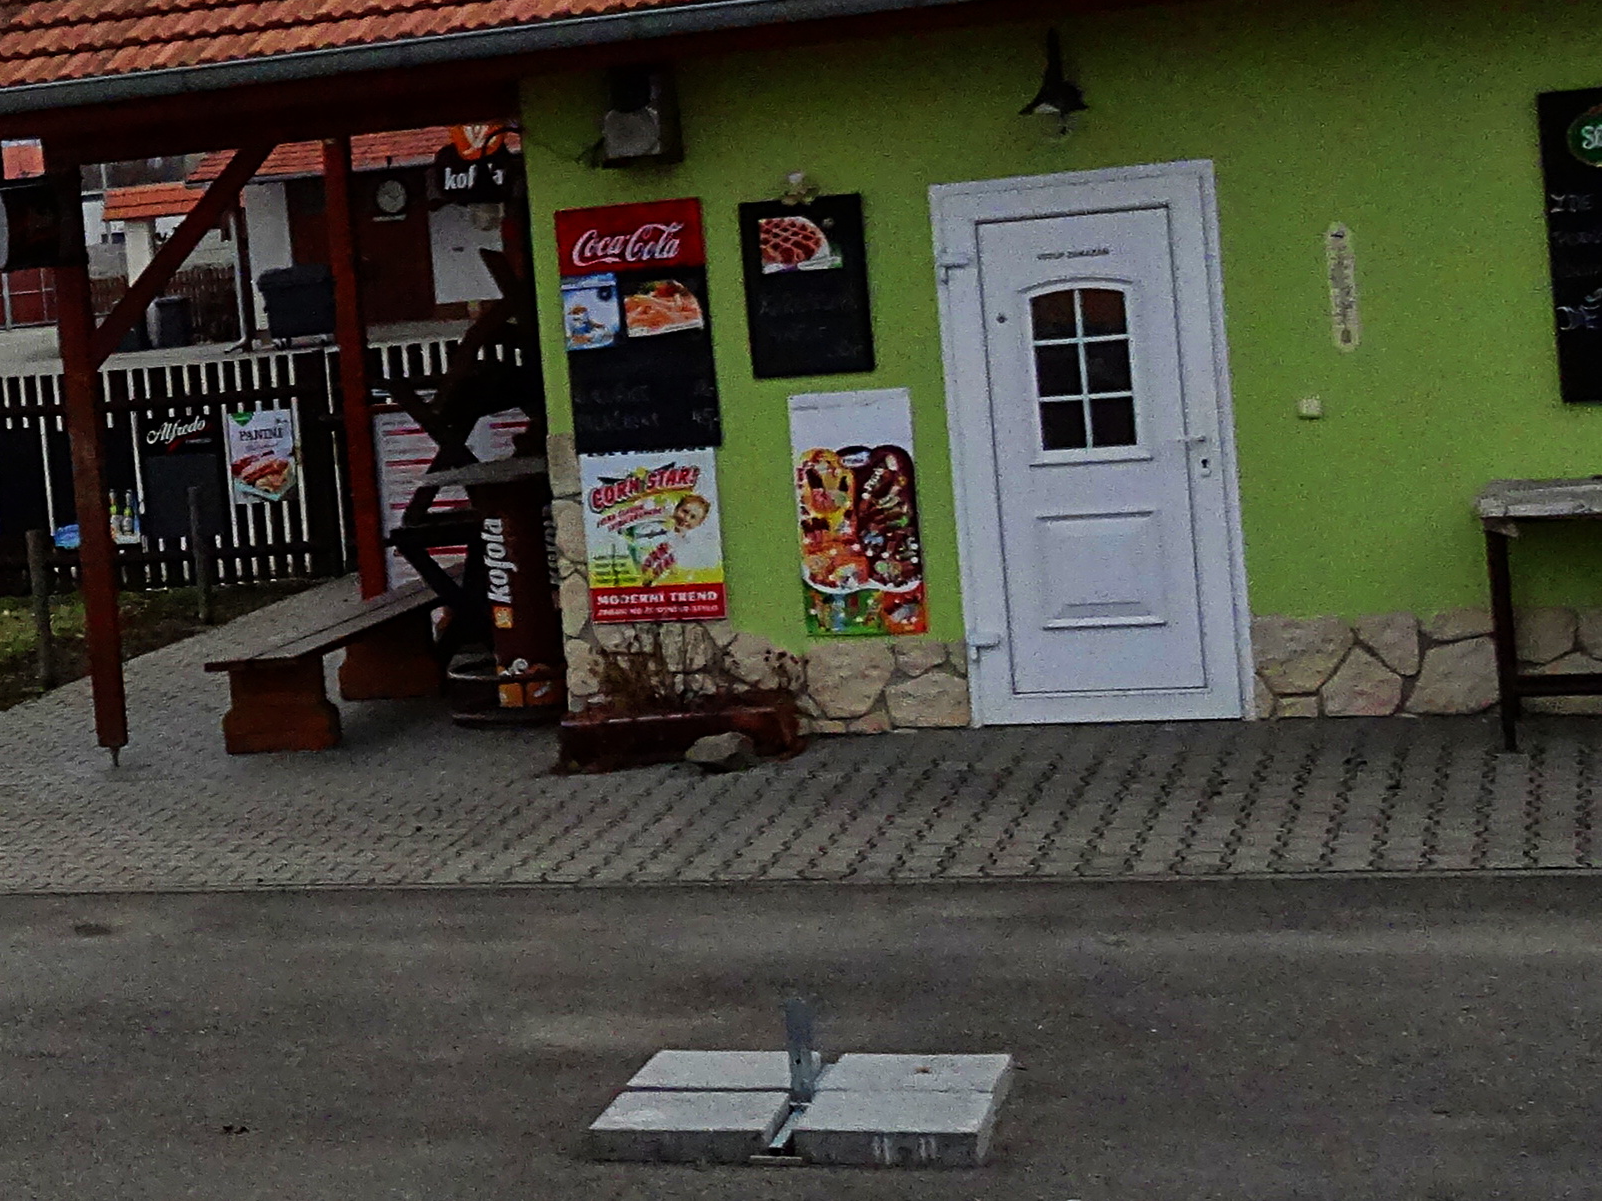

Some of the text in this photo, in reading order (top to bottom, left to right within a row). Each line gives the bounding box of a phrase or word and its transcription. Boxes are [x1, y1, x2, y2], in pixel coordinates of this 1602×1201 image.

[572, 222, 685, 266] Coca-Cola
[147, 415, 206, 444] Alfredo
[590, 476, 641, 512] CORN
[481, 518, 519, 603] kofola
[669, 590, 718, 602] TREND
